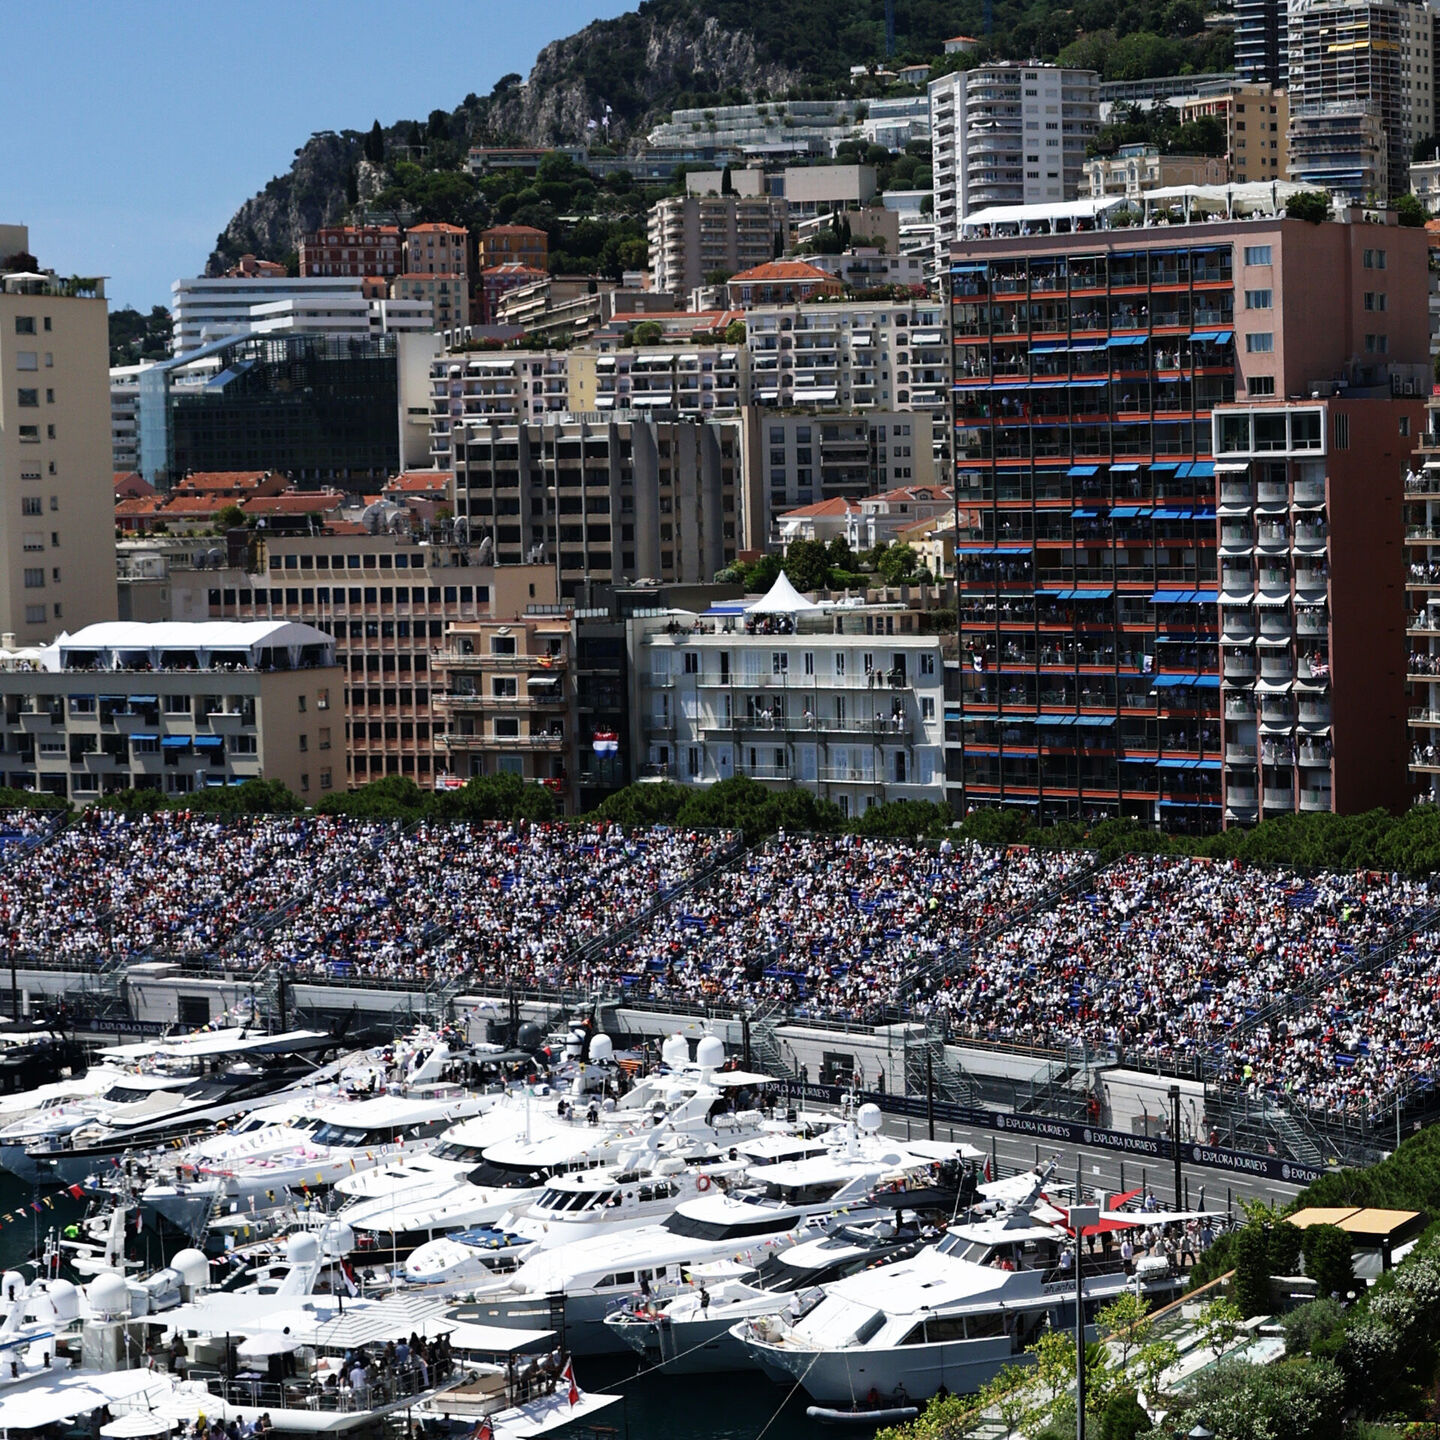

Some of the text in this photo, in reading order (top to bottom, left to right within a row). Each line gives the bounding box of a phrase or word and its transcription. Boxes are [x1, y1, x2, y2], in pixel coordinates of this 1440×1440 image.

[1005, 1118, 1071, 1138] EXPLORA JOURNEYS
[1092, 1132, 1158, 1153] EXPLORA JOURNEYS
[1202, 1150, 1269, 1173] EXPLORA JOURNEYS
[1291, 1167, 1322, 1182] EXPLORA
